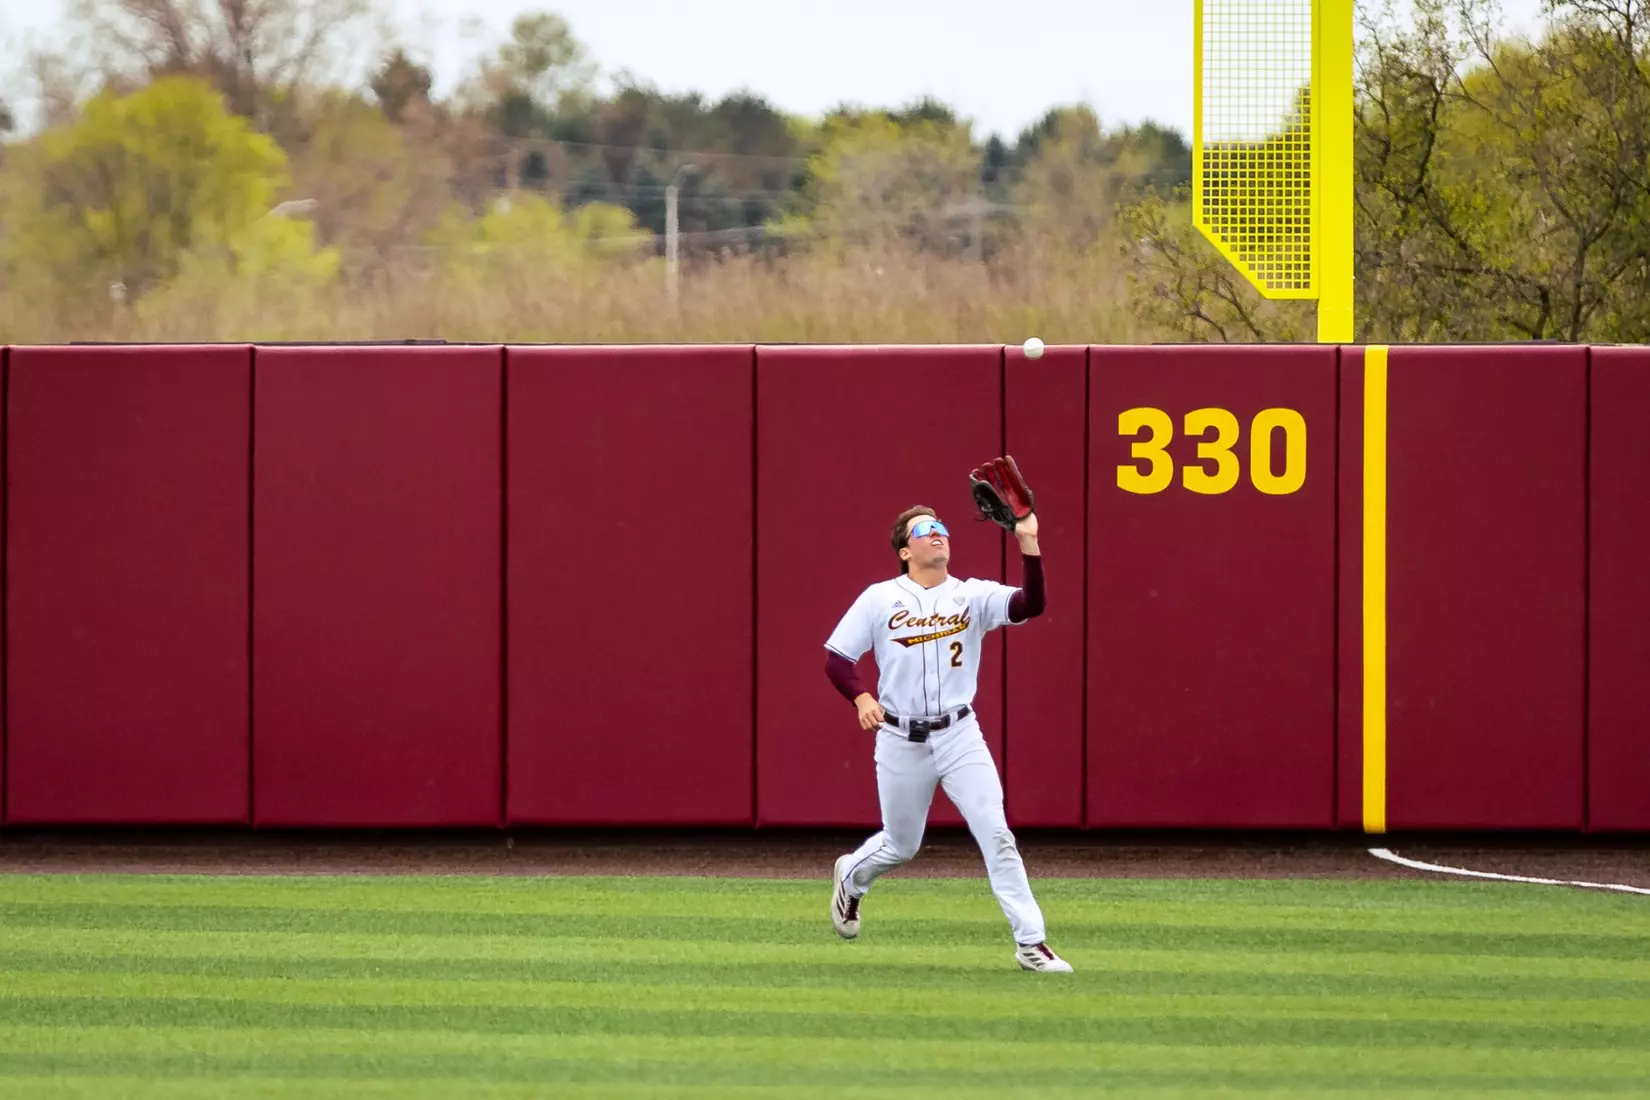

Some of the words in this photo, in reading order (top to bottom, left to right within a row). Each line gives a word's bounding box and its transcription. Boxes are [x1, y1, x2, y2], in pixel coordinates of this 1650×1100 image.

[1116, 407, 1307, 495] 330
[888, 605, 971, 630] Central
[949, 640, 963, 667] 2
